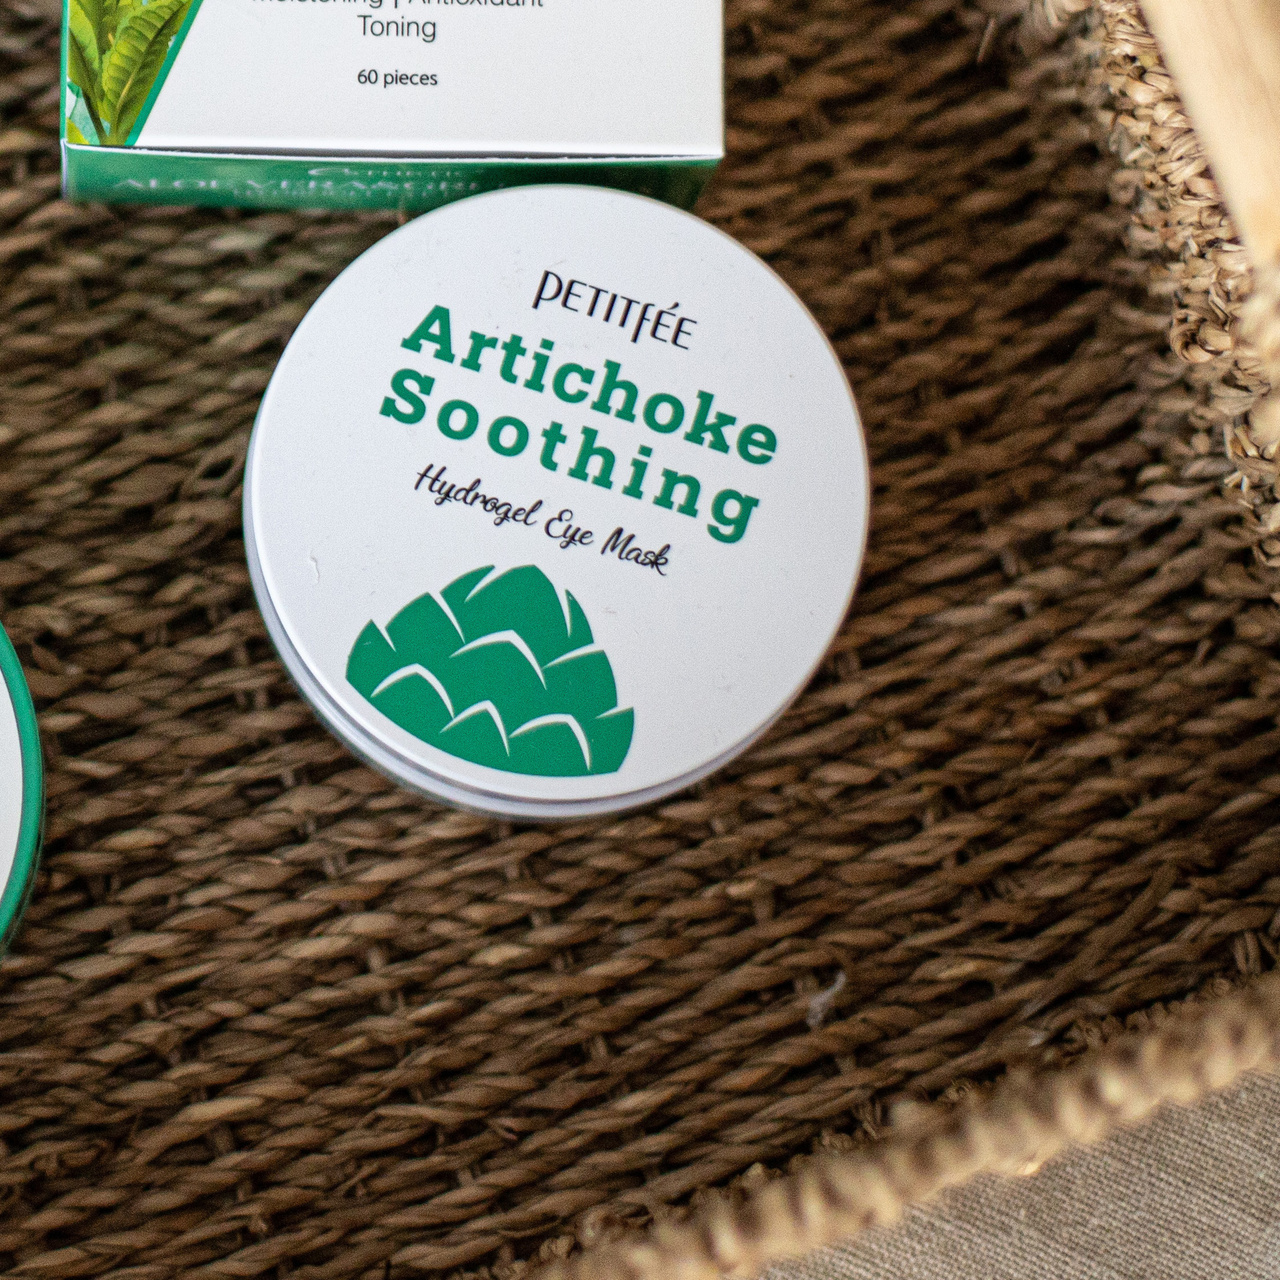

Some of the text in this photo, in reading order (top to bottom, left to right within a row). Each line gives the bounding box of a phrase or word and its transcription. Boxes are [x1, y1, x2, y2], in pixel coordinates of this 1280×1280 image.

[356, 14, 438, 44] Toning
[356, 67, 439, 90] 60 pieces
[399, 304, 778, 466] Artichoke
[378, 367, 761, 545] Soothing
[413, 462, 672, 578] Hydrogel Eye Mask
